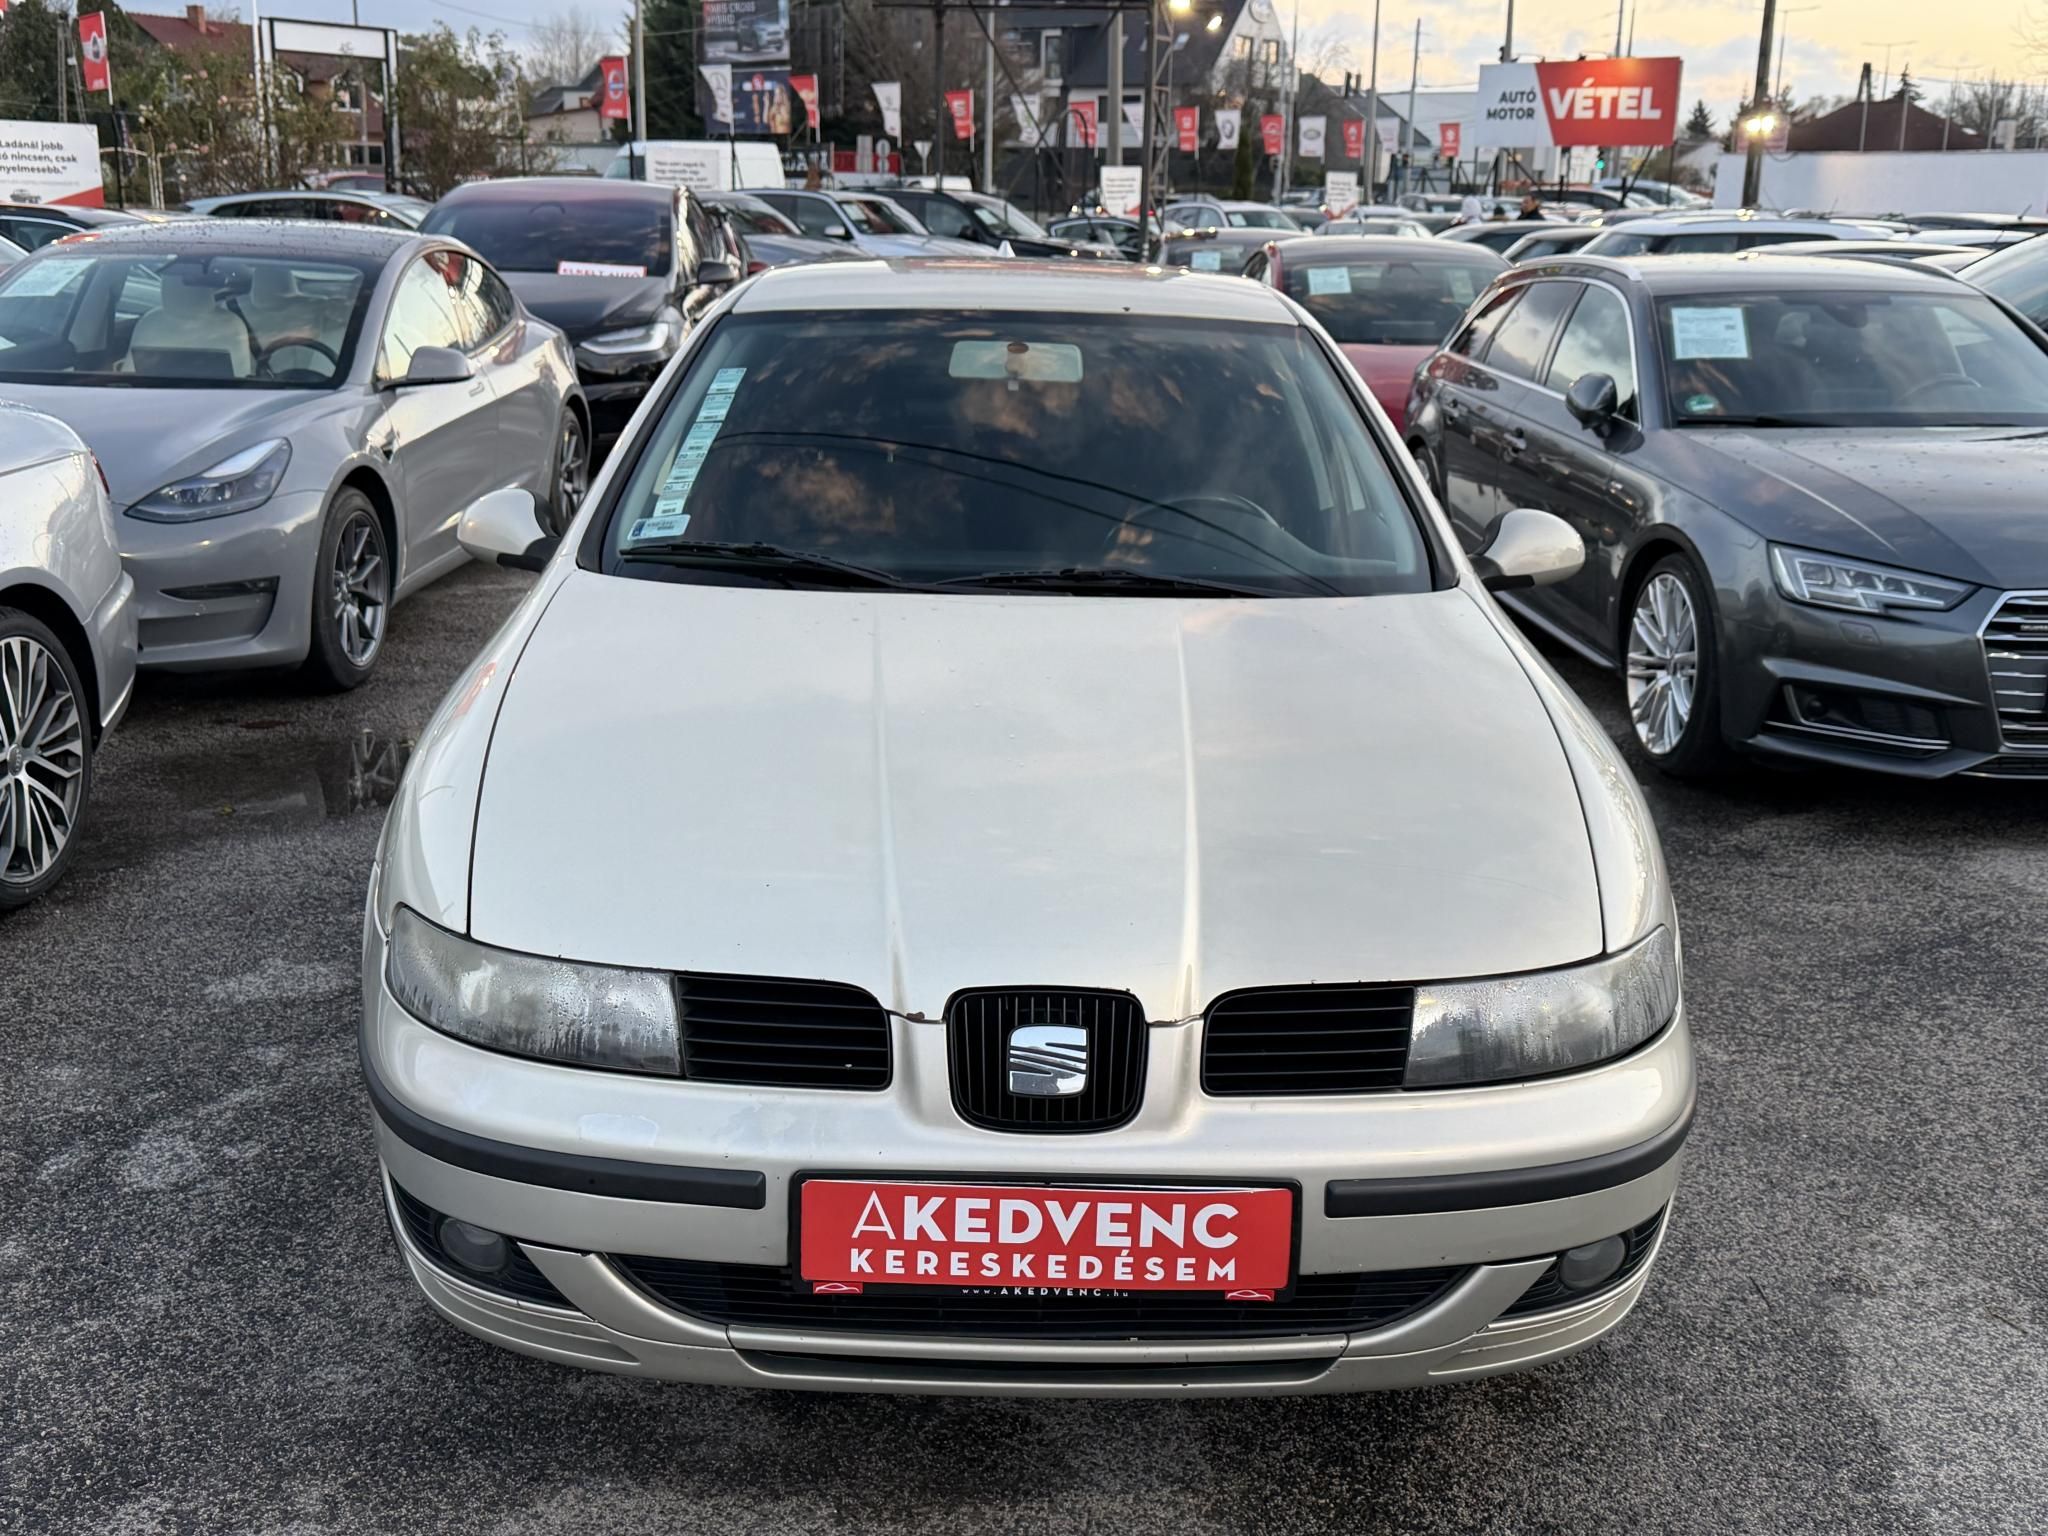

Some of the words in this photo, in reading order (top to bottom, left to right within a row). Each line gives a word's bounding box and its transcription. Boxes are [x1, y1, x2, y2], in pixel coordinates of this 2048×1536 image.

[1499, 87, 1536, 104] AUTÓ
[1549, 77, 1662, 120] VÉTEL
[1486, 107, 1535, 120] MOTOR
[41, 140, 63, 151] jobb
[11, 151, 53, 163] nincsen,
[55, 154, 77, 163] csak
[850, 1247, 1236, 1282] KERESKEDÉSEM
